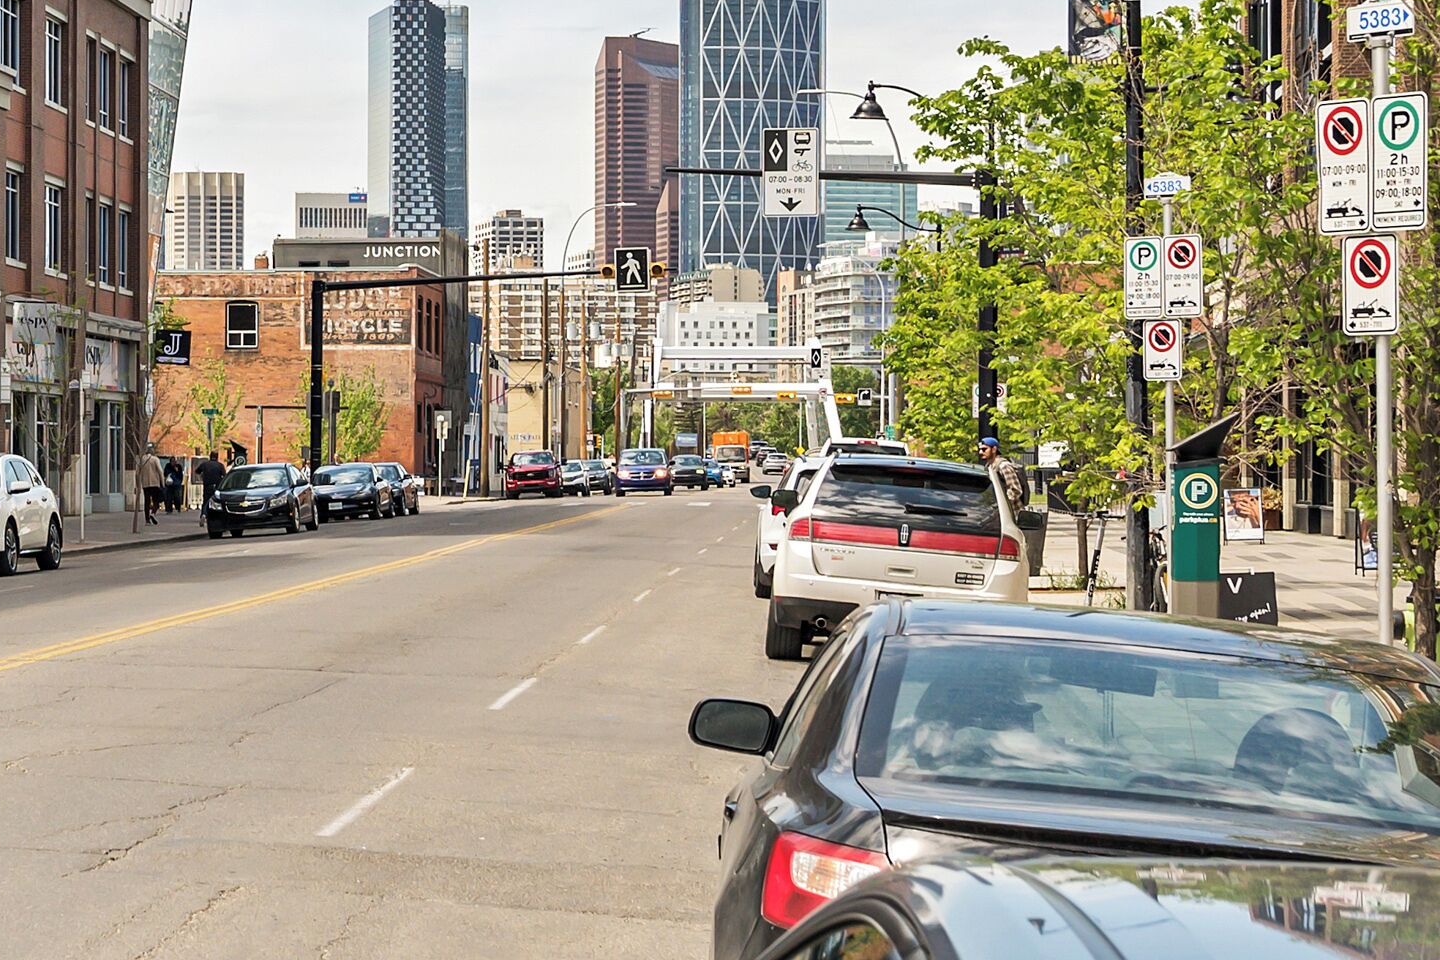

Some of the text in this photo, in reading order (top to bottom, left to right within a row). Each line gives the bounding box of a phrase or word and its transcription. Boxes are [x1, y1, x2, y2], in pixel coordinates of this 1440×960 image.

[1359, 8, 1401, 30] 5383
[1376, 166, 1420, 179] 11:00-15:30
[1152, 180, 1183, 193] 5383
[1375, 187, 1422, 199] 09:00-18:00
[363, 245, 441, 258] JUNCTION
[20, 317, 48, 329] espy
[363, 332, 395, 341] 1869
[1191, 481, 1208, 502] P
[1226, 577, 1242, 594] V
[1250, 602, 1271, 620] open!
